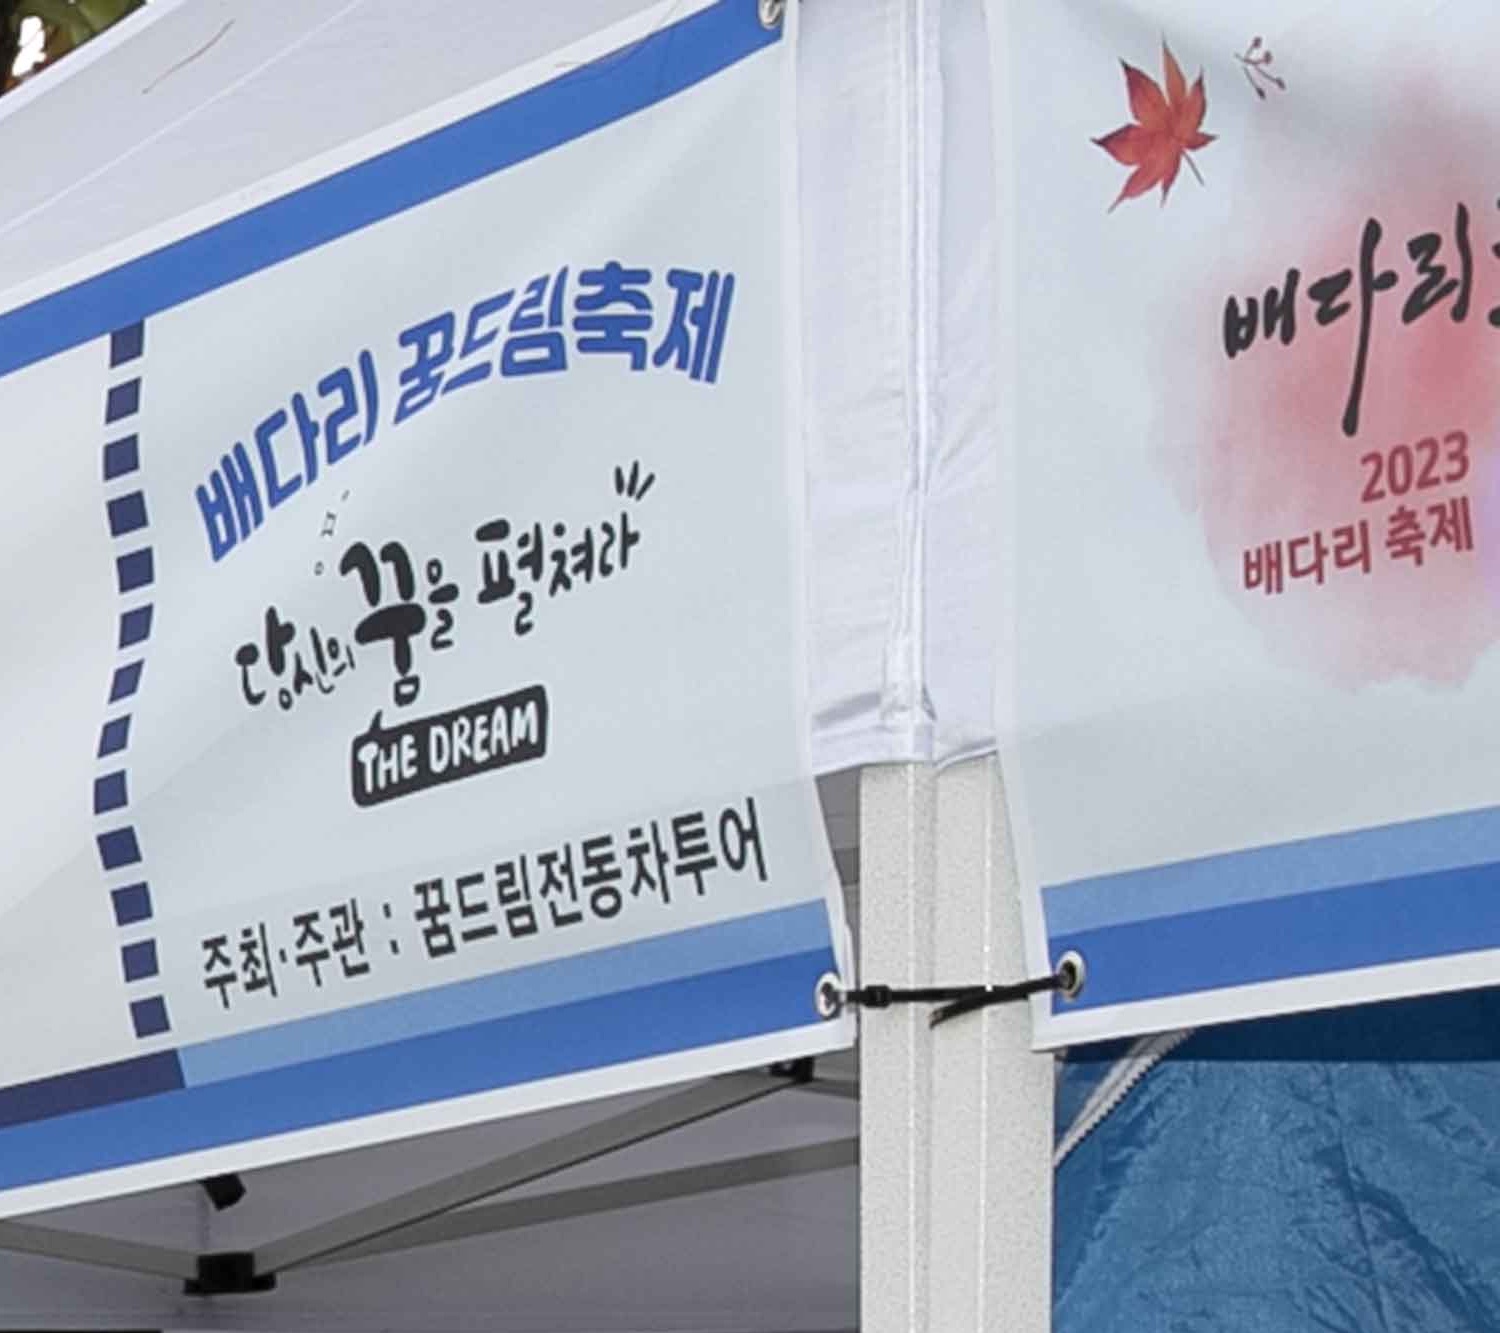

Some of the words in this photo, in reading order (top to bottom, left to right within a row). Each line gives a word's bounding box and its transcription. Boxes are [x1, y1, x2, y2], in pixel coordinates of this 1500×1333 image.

[1222, 195, 1500, 437] 배다리
[195, 348, 379, 562] 배다리
[393, 260, 735, 425] 꿈드림축제
[1359, 430, 1470, 502] 2023
[235, 605, 356, 710] 당신의
[339, 541, 460, 706] 꿈을
[475, 511, 640, 636] 펼쳐라
[1243, 519, 1371, 594] 배다리
[1385, 496, 1474, 567] 축제
[358, 736, 419, 794] THE
[429, 700, 539, 775] DREAM
[413, 796, 769, 958] 꿈드림전동차투어
